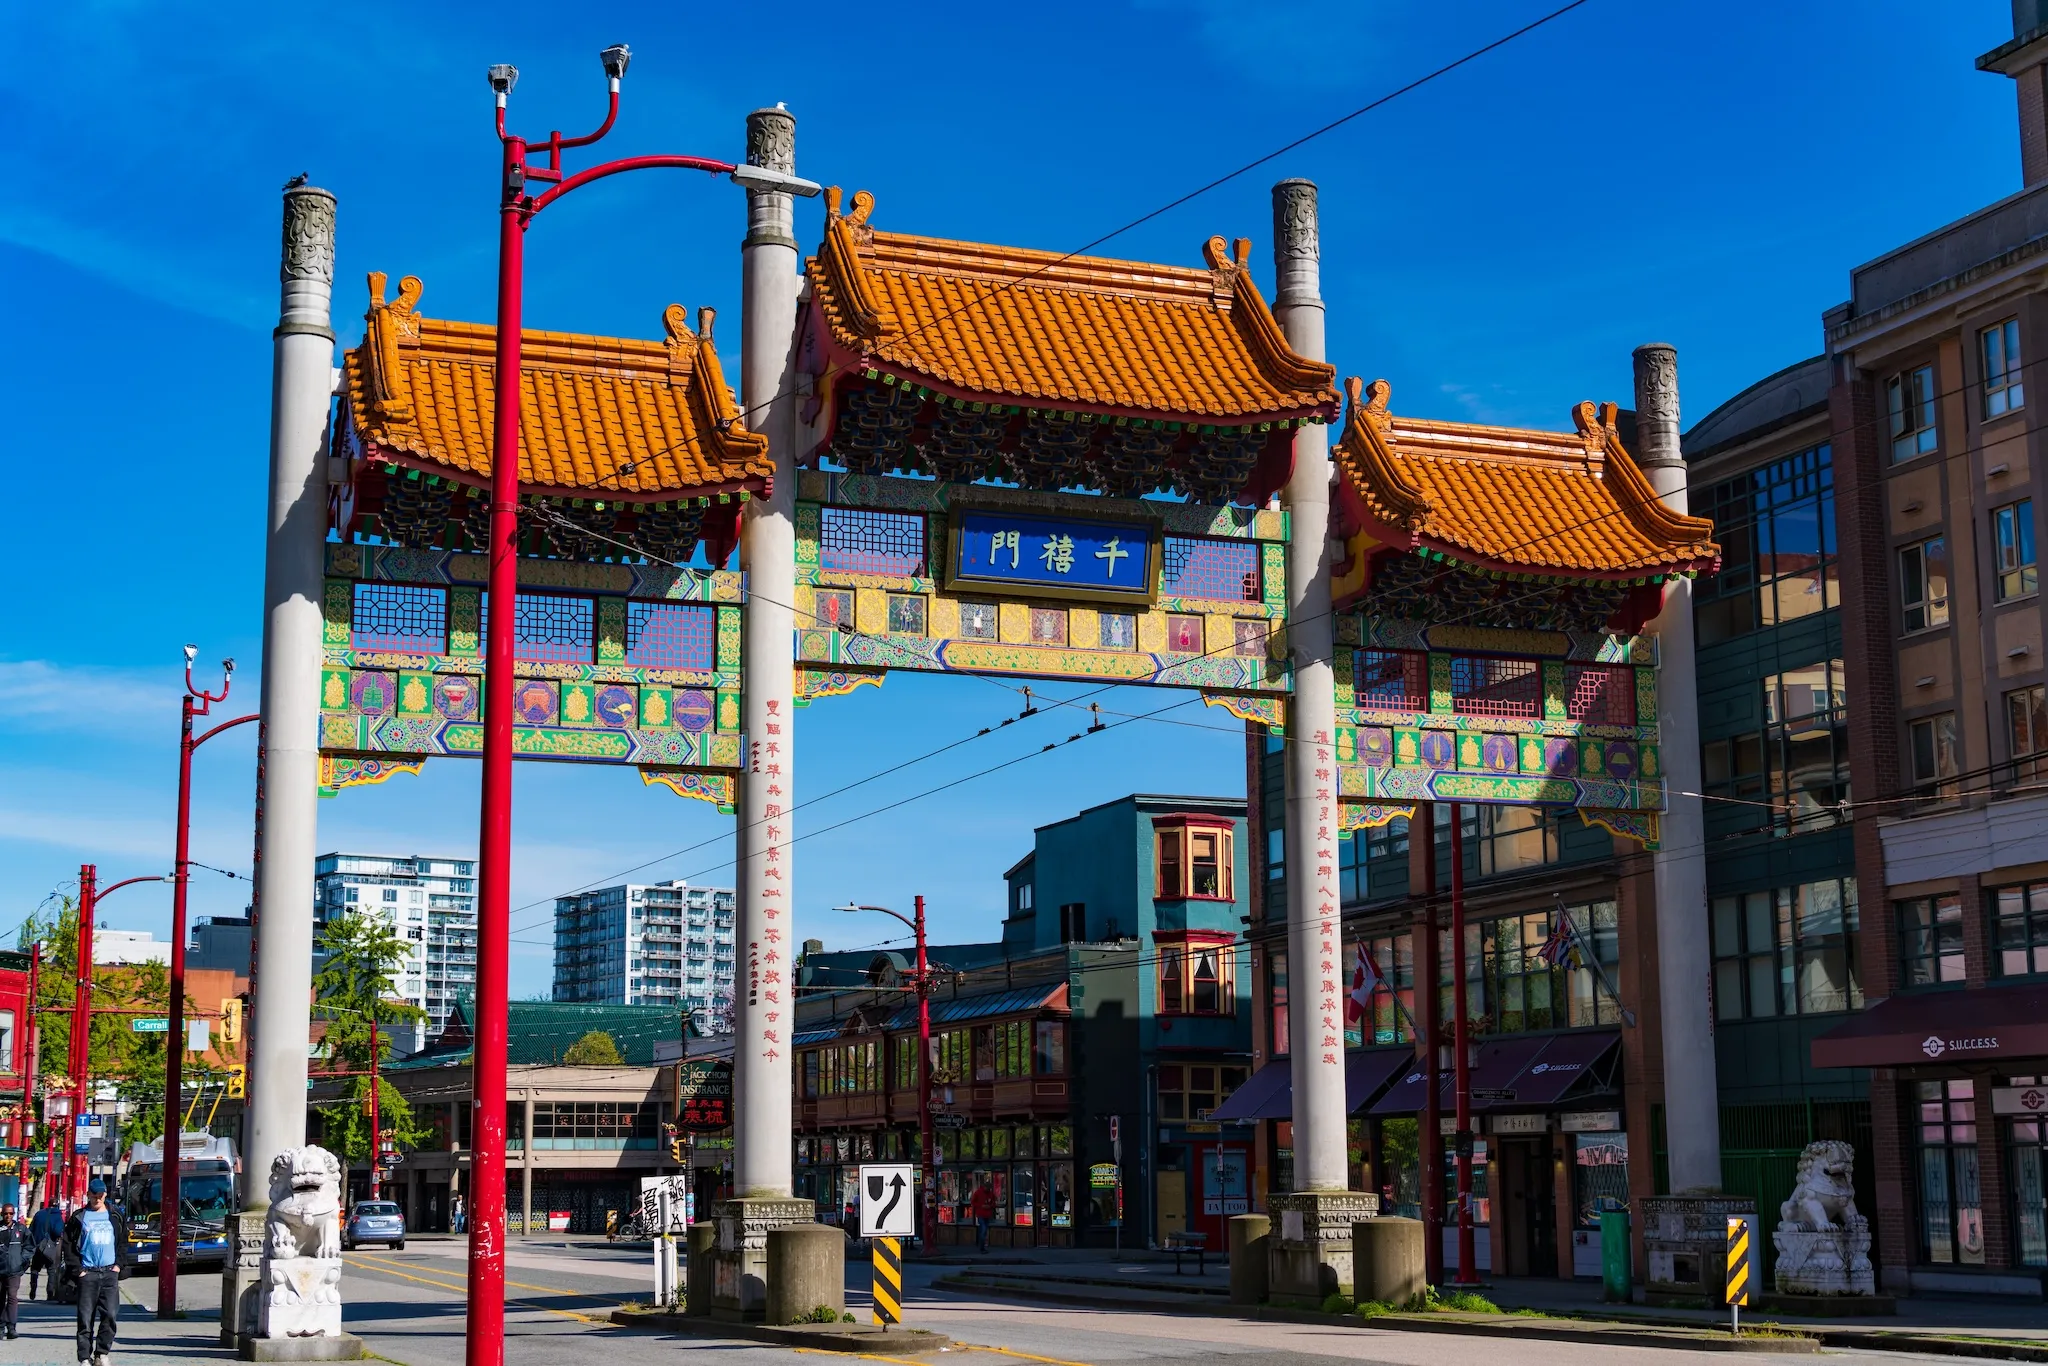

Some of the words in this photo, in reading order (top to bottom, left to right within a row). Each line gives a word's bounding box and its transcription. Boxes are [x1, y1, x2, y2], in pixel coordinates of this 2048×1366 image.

[989, 529, 1129, 579] 千禧門
[137, 1021, 168, 1030] Carrall
[1949, 1037, 1999, 1051] S.U.C.C.E.S.S.
[707, 1071, 729, 1080] CHOW
[681, 1084, 730, 1095] INSURANCE
